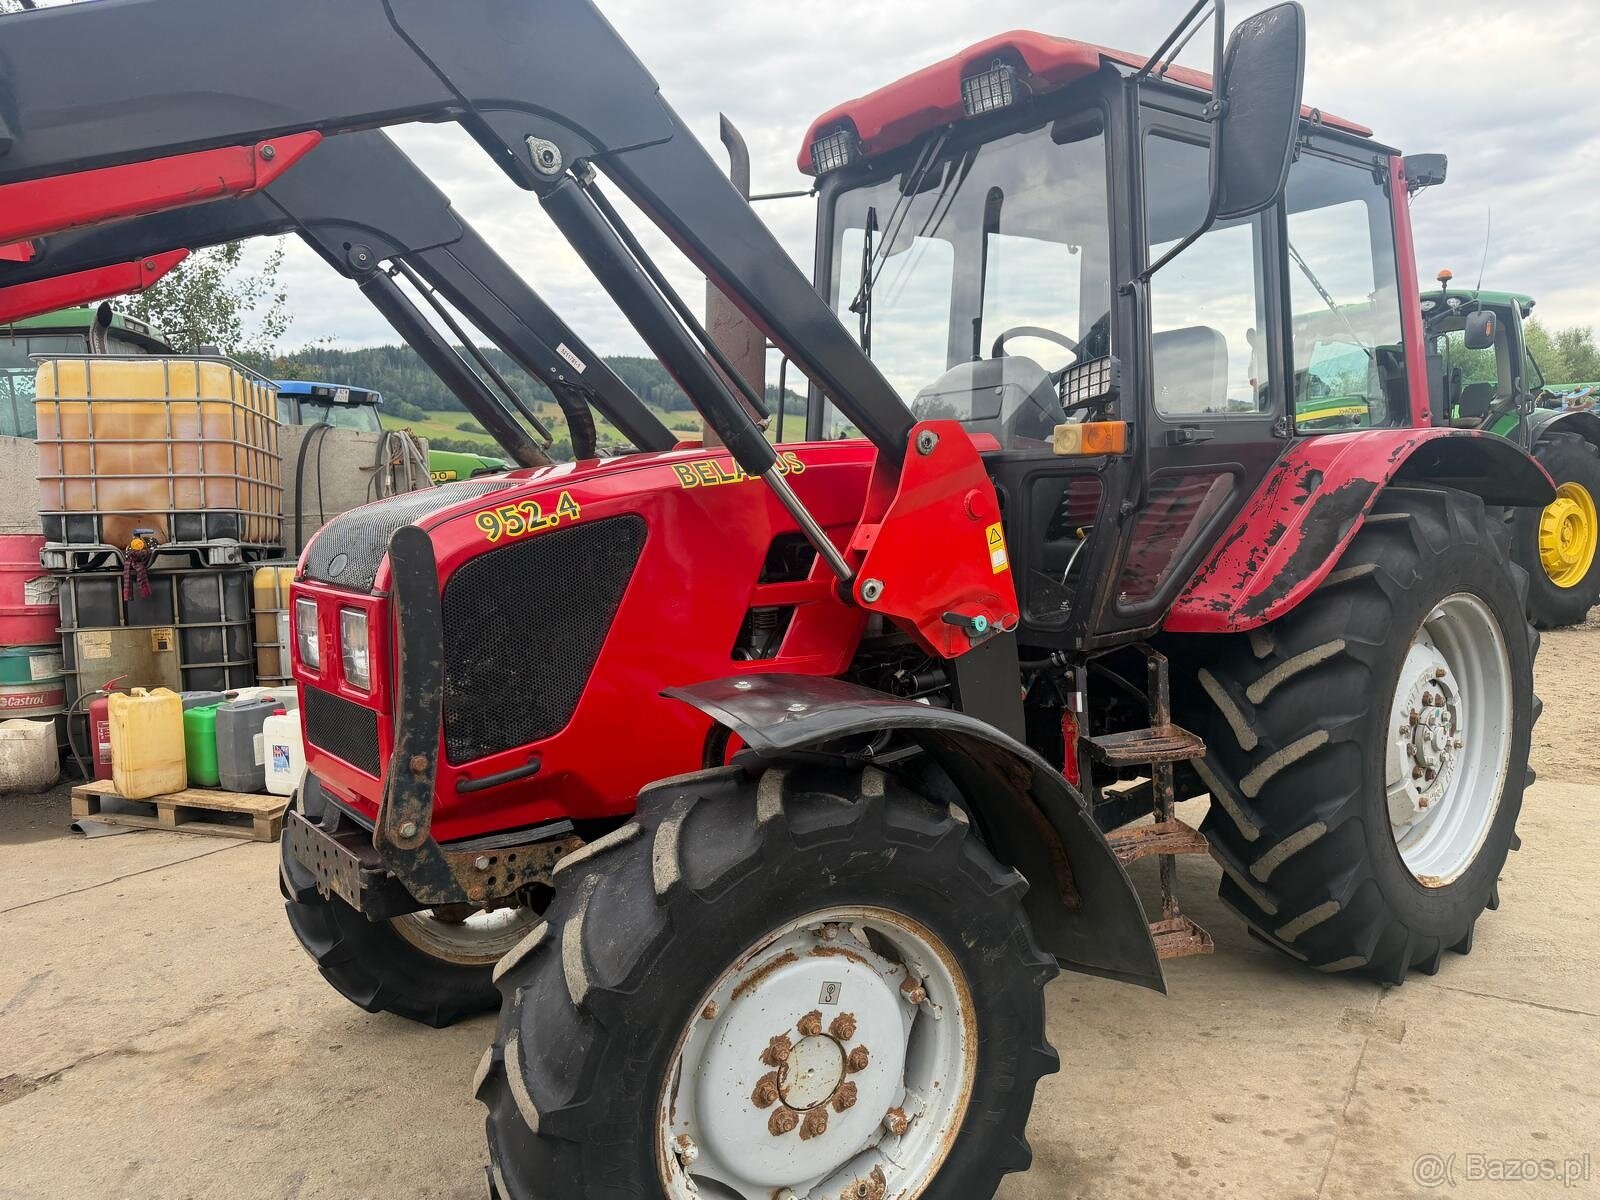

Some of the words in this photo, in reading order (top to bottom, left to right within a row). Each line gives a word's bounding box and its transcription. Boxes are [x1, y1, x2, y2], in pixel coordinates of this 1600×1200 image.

[672, 452, 806, 489] BELAUS
[475, 491, 582, 542] 952.4
[8, 694, 45, 706] Castrol
